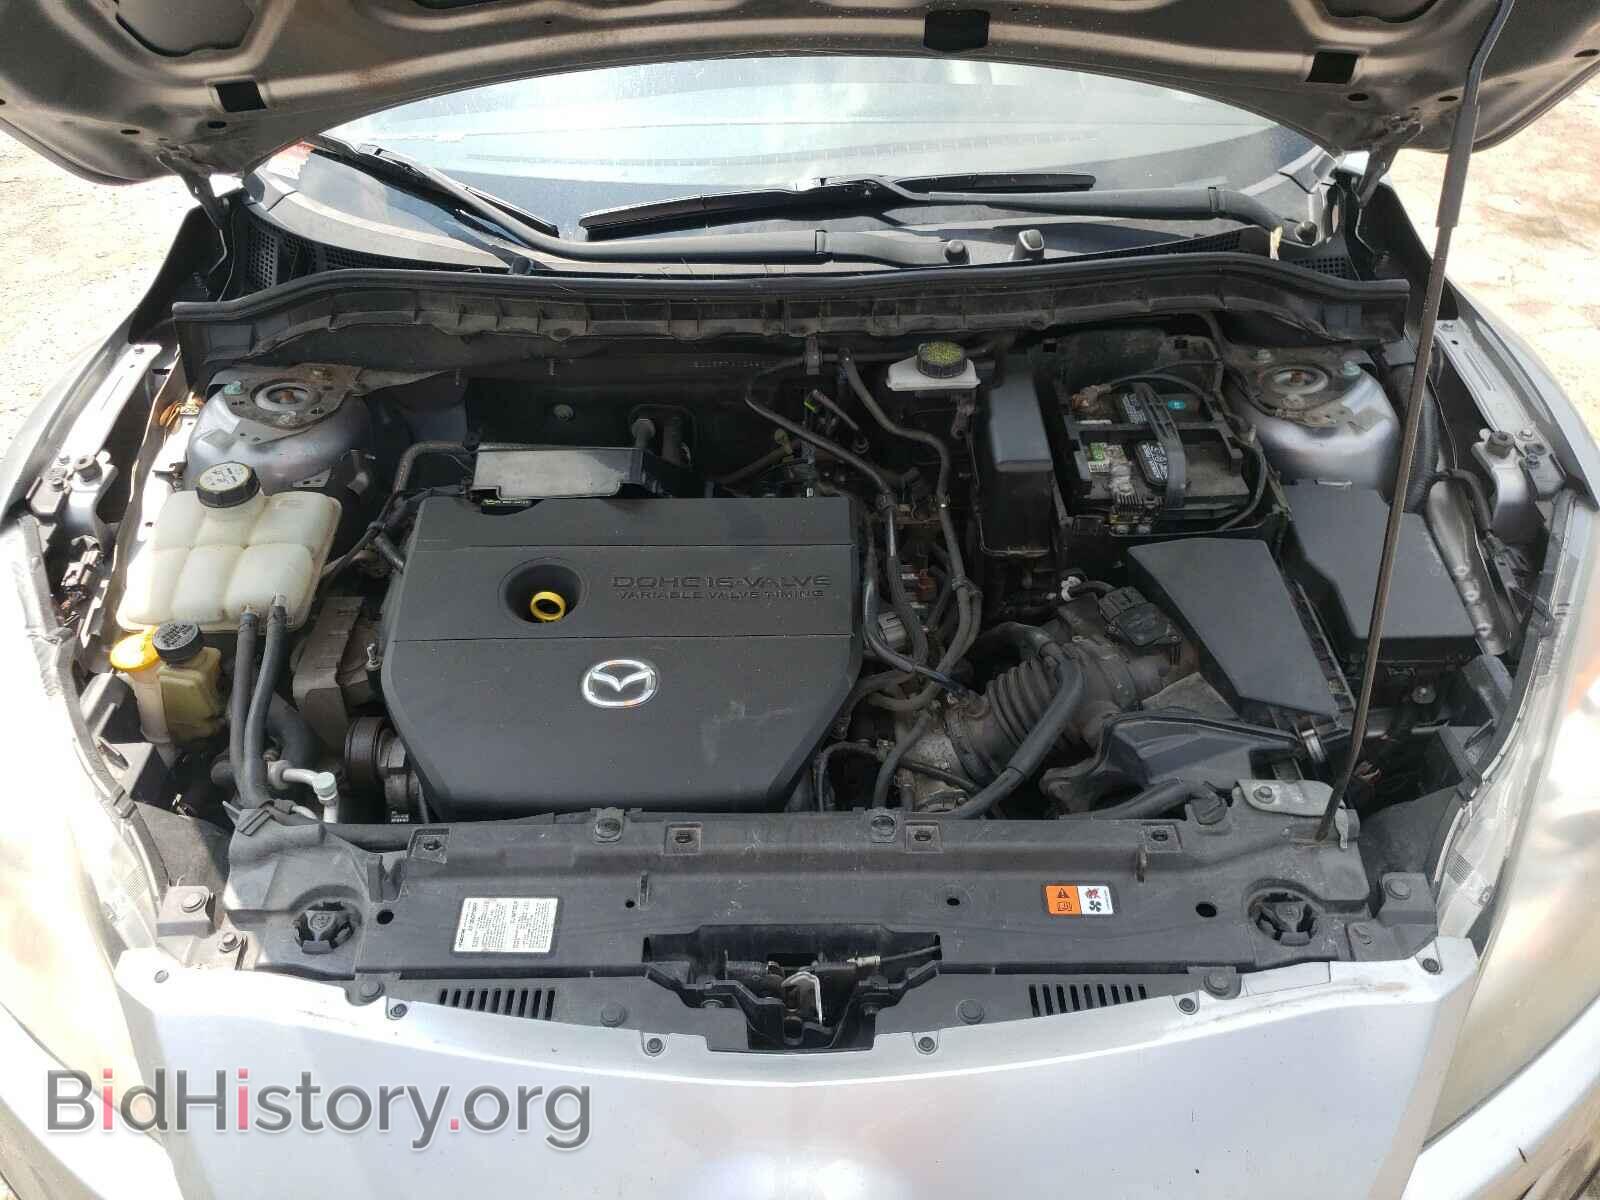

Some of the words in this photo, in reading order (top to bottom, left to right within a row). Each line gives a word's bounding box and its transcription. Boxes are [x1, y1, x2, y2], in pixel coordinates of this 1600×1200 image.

[613, 576, 701, 588] DOHC
[704, 575, 832, 588] 16-VALVE
[619, 591, 705, 600] VARIABLE
[709, 591, 763, 600] VALVE
[766, 590, 825, 600] TIMING
